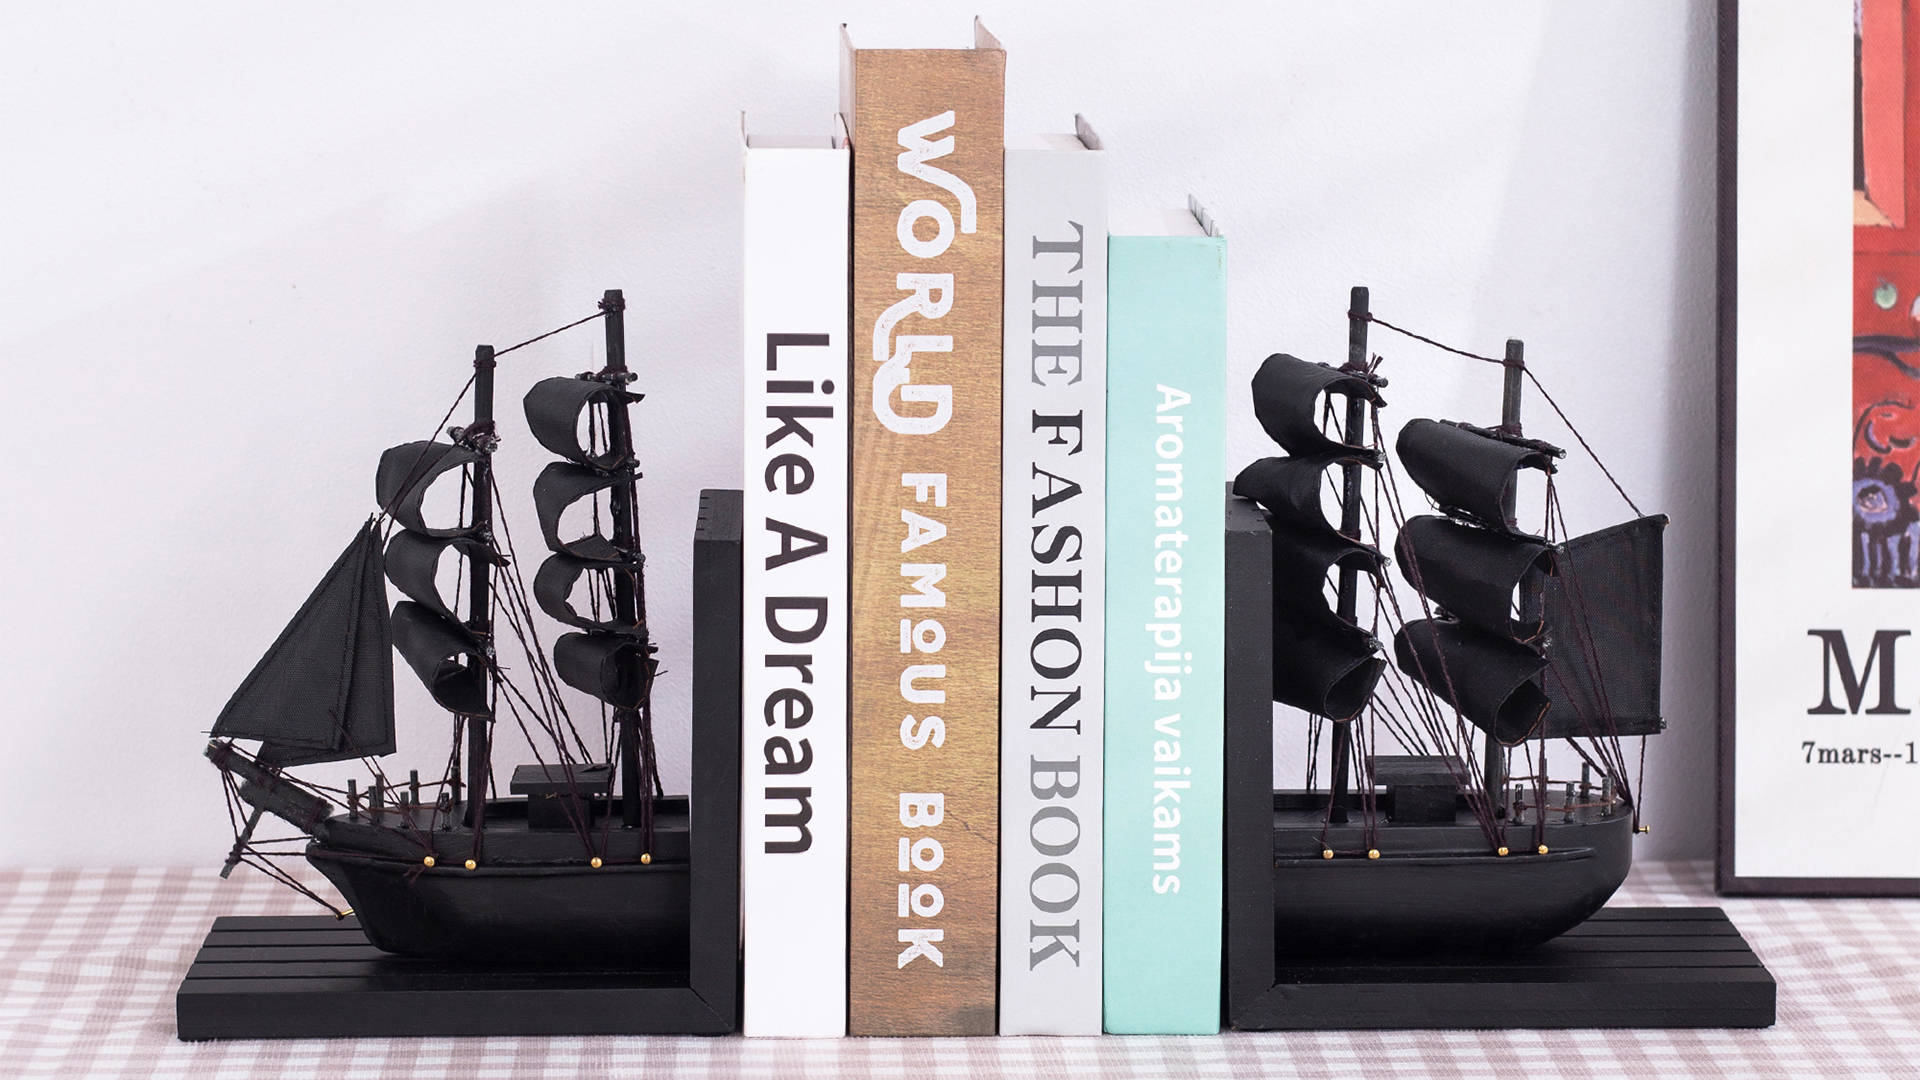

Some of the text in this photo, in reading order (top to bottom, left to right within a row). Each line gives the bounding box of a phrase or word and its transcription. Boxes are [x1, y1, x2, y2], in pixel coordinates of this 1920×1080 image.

[763, 333, 835, 854] Like A Dream
[873, 109, 977, 970] WORLD FAMOUS BOOK
[1029, 220, 1084, 972] THE FASHON BOOK
[1144, 382, 1194, 895] Aromaterapija vaikams
